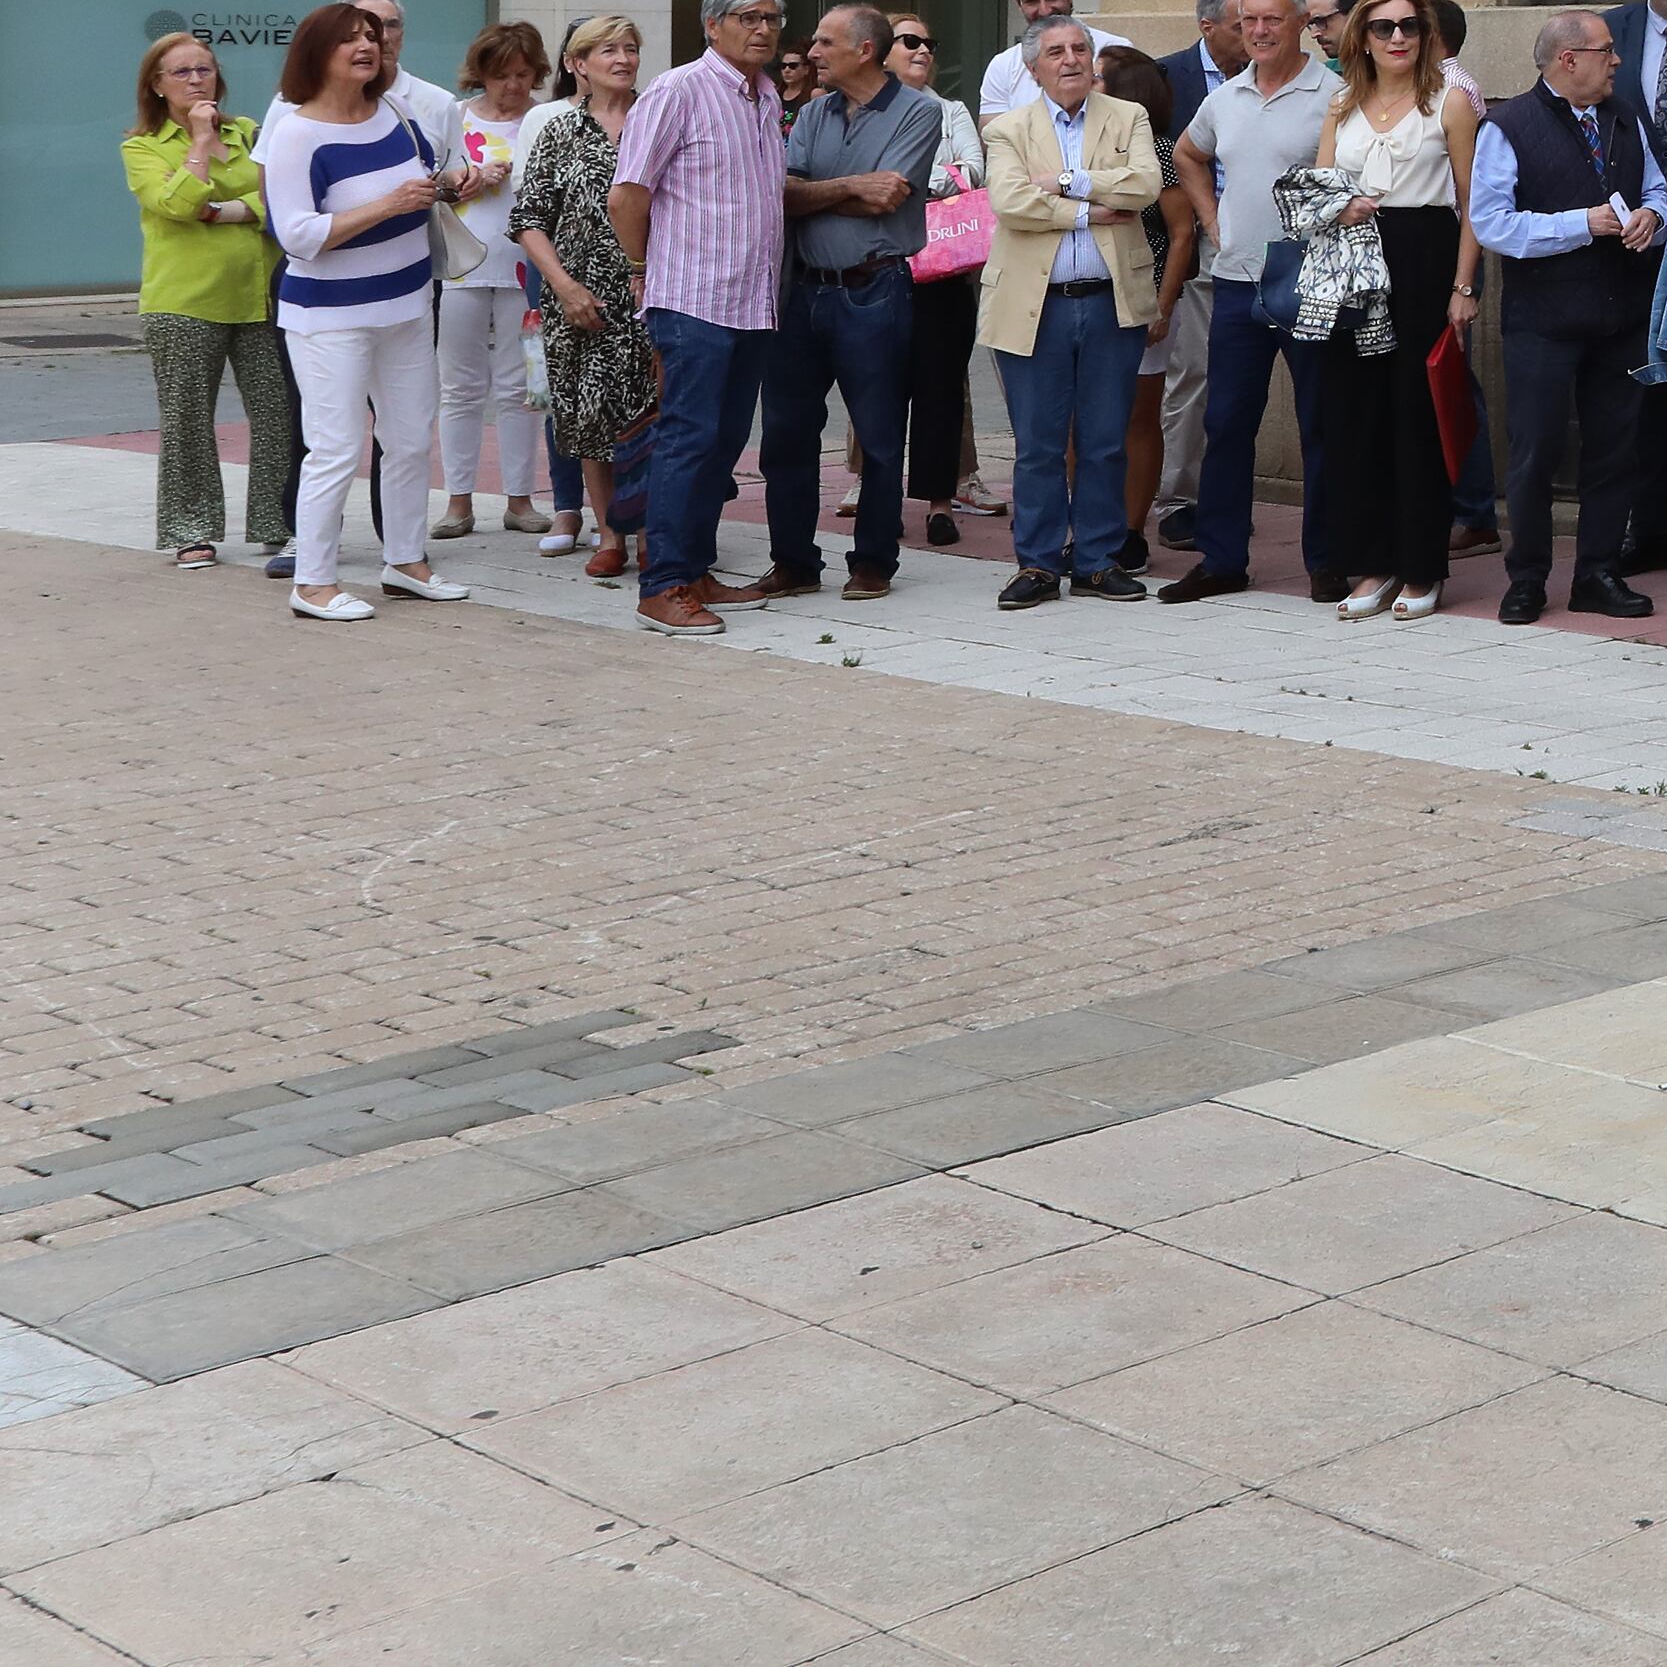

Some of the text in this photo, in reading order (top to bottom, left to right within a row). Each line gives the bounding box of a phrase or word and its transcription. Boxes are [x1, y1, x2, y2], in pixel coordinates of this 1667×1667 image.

[192, 13, 297, 27] CLINICA
[193, 29, 292, 45] BAVIE
[928, 219, 978, 242] DRUNI
